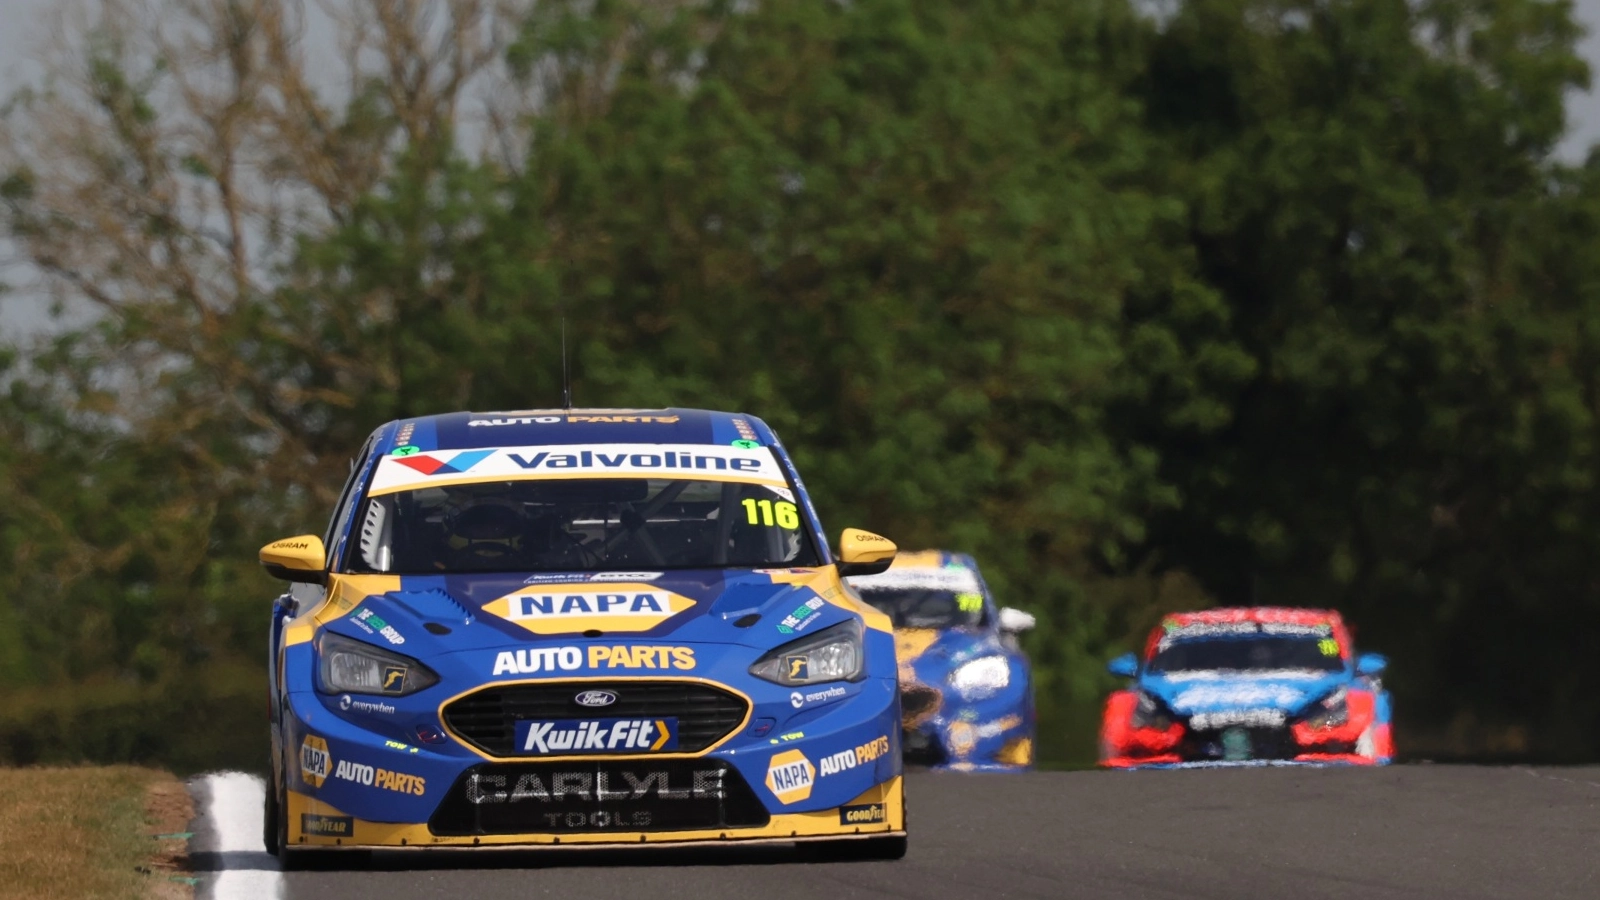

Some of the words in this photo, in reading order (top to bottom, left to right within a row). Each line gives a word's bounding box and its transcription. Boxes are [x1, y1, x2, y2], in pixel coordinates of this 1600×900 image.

[468, 416, 562, 427] AUTO
[567, 415, 680, 424] PARTS
[506, 450, 762, 473] Valvoline
[741, 498, 799, 530] 116
[272, 542, 309, 551] OSRAM
[520, 593, 664, 616] NAPA
[492, 646, 582, 676] AUTO
[587, 645, 697, 671] PARTS
[805, 686, 846, 702] everywhen
[352, 700, 395, 715] everywhen
[384, 740, 407, 750] TOW
[780, 731, 804, 742] TOW
[302, 747, 326, 775] NAPA
[820, 749, 857, 776] AUTO
[856, 735, 890, 764] PARTS
[335, 759, 375, 786] AUTO
[374, 768, 426, 796] PARTS
[465, 770, 726, 804] CARLYLE
[773, 765, 810, 792] NAPA
[543, 811, 652, 828] TOOLS
